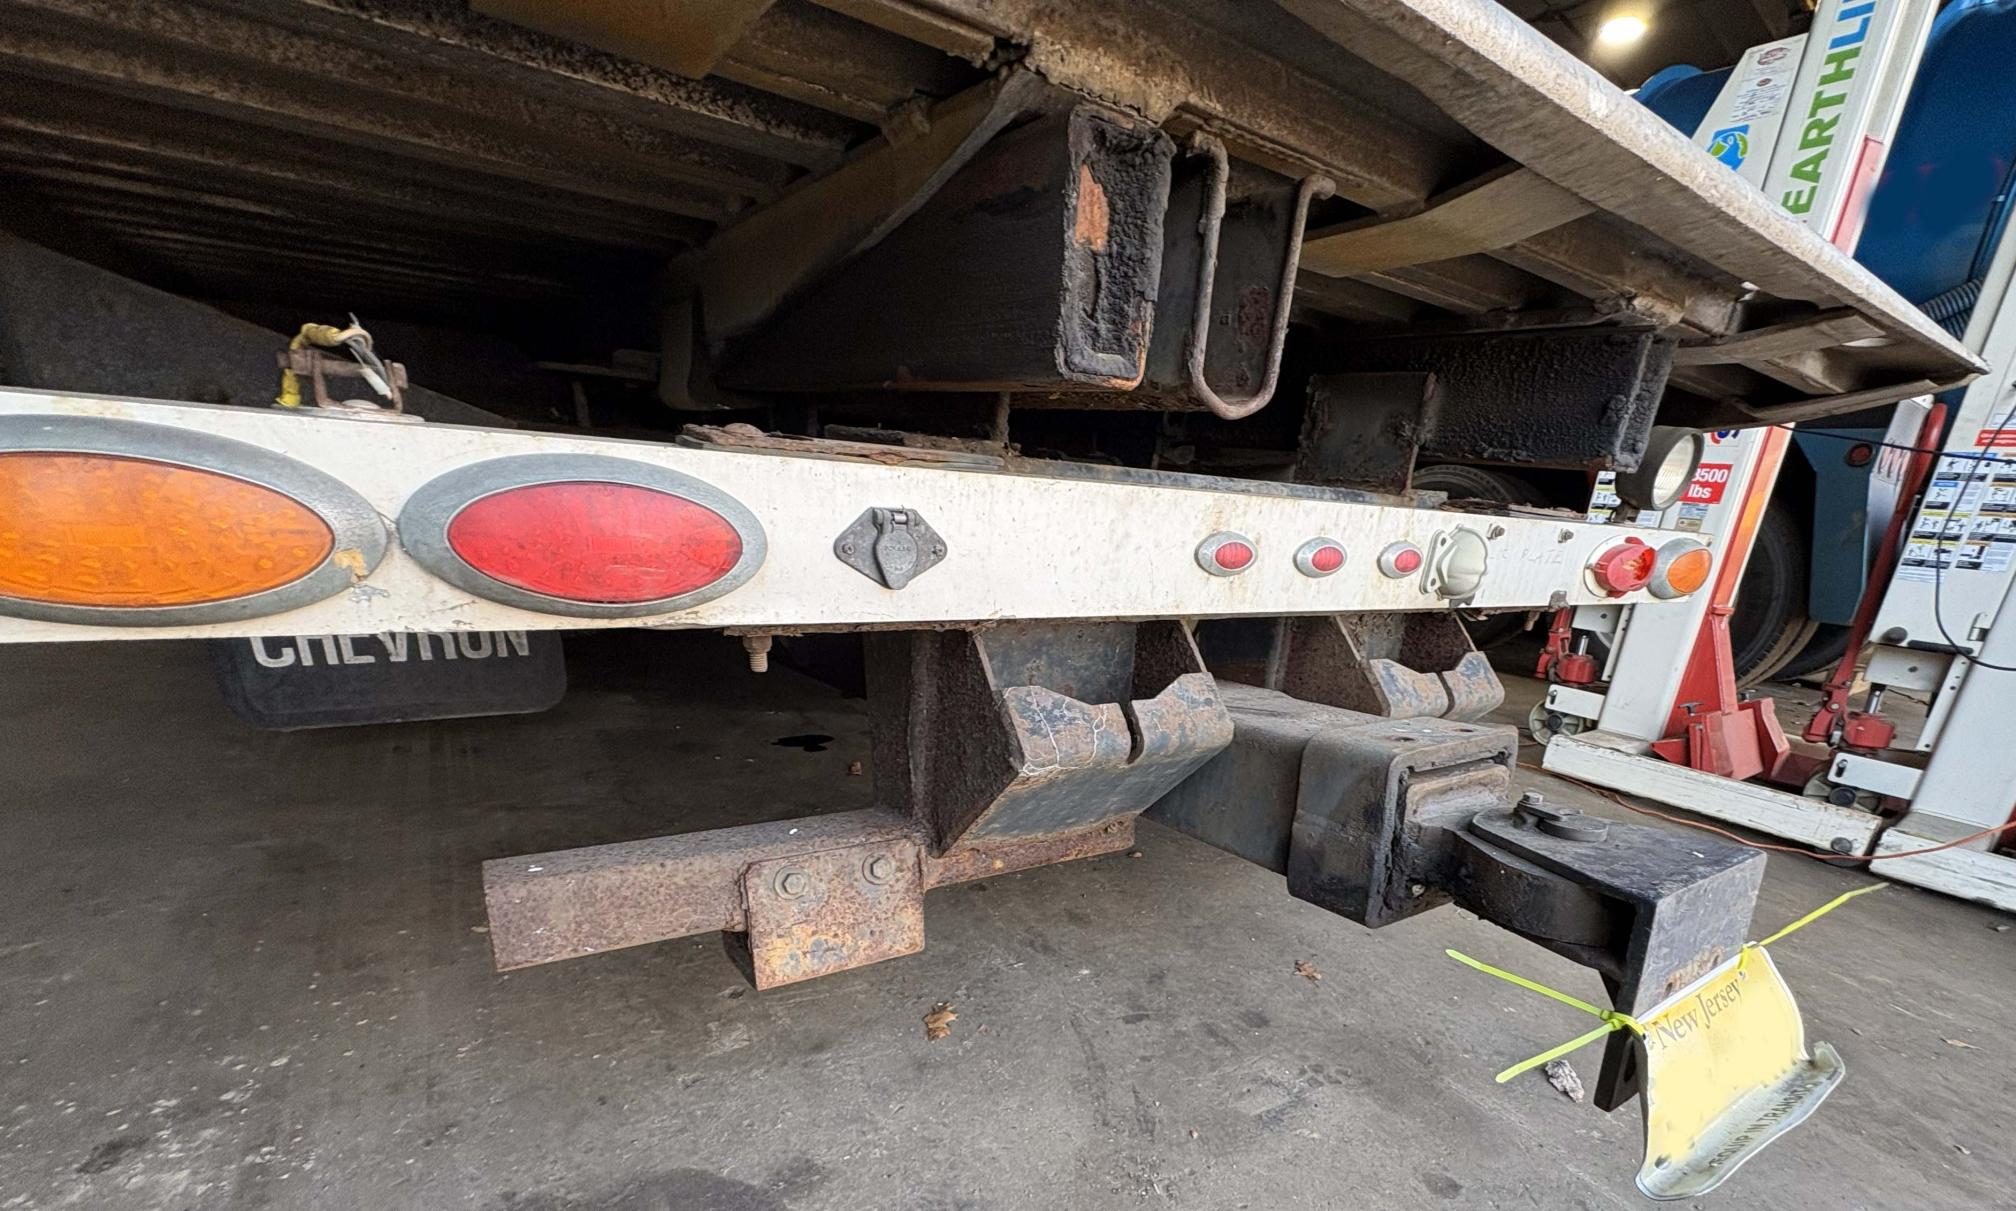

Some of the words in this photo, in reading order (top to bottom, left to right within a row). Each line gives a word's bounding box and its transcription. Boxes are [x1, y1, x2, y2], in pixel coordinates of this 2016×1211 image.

[1781, 0, 1876, 215] EARTHLI
[1687, 483, 1712, 499] lbs
[1652, 1008, 1700, 1050] New
[1695, 978, 1744, 1030] Jersey
